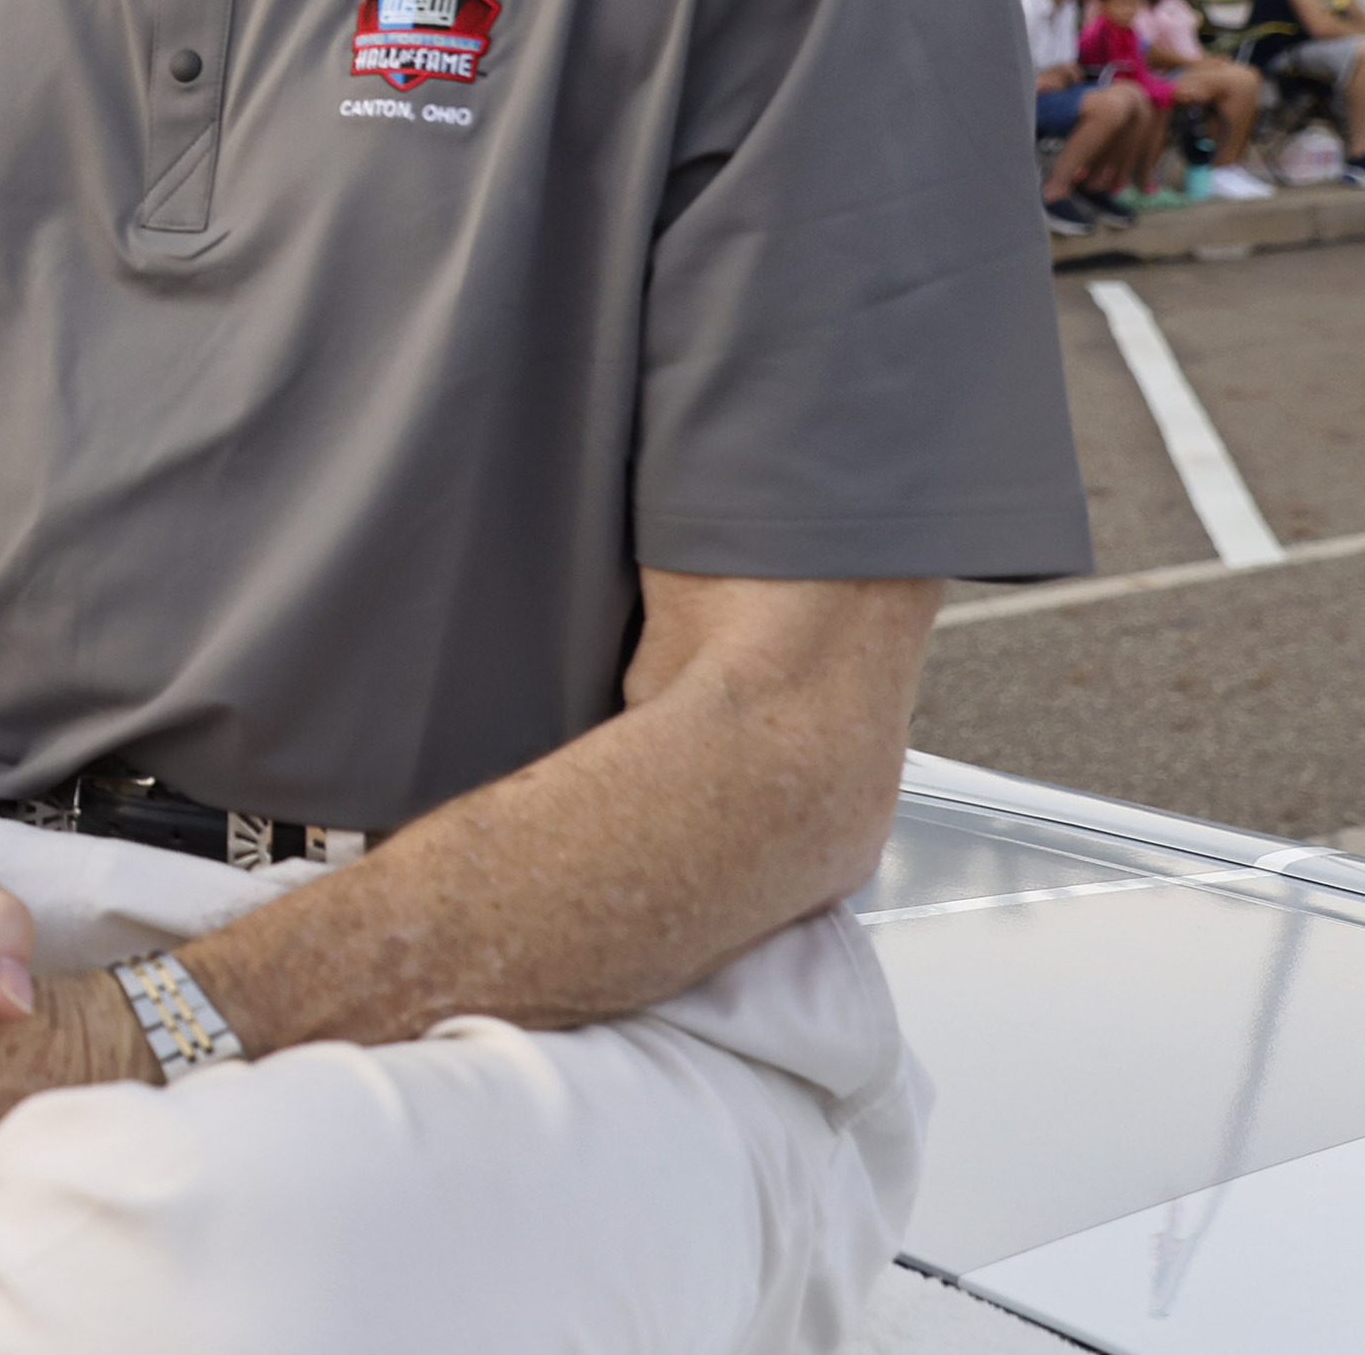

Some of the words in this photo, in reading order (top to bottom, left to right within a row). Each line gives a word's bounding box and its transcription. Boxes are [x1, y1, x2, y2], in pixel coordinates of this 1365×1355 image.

[355, 48, 401, 70] HALL
[413, 48, 473, 77] FAME
[339, 99, 415, 122] CANTON,
[421, 103, 473, 126] OHIO
